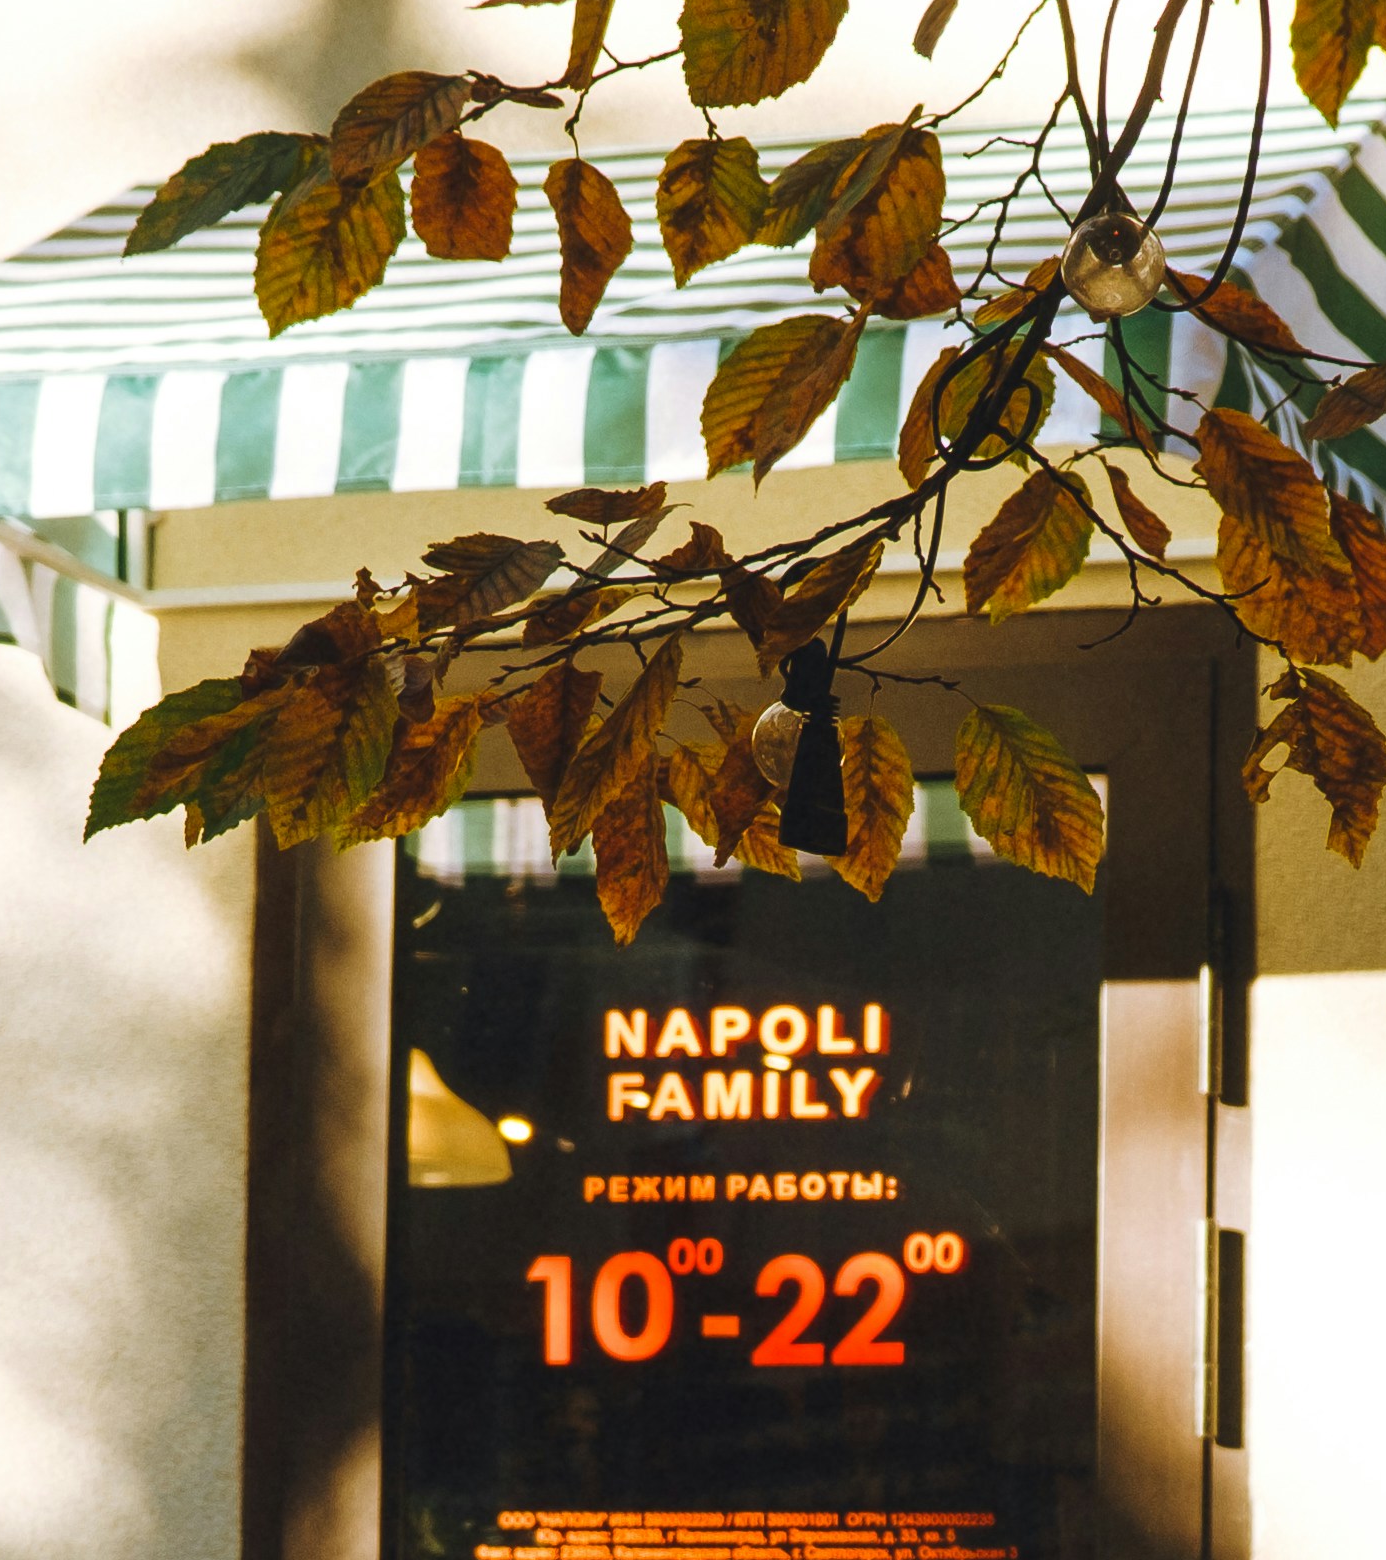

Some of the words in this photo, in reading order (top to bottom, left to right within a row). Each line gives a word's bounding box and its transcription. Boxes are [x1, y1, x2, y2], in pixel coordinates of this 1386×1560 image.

[604, 1003, 885, 1058] NAPOLI
[607, 1067, 877, 1121] FAMILY
[583, 1174, 716, 1203] РЕЖИМ
[725, 1171, 898, 1201] РАБОТЫ:
